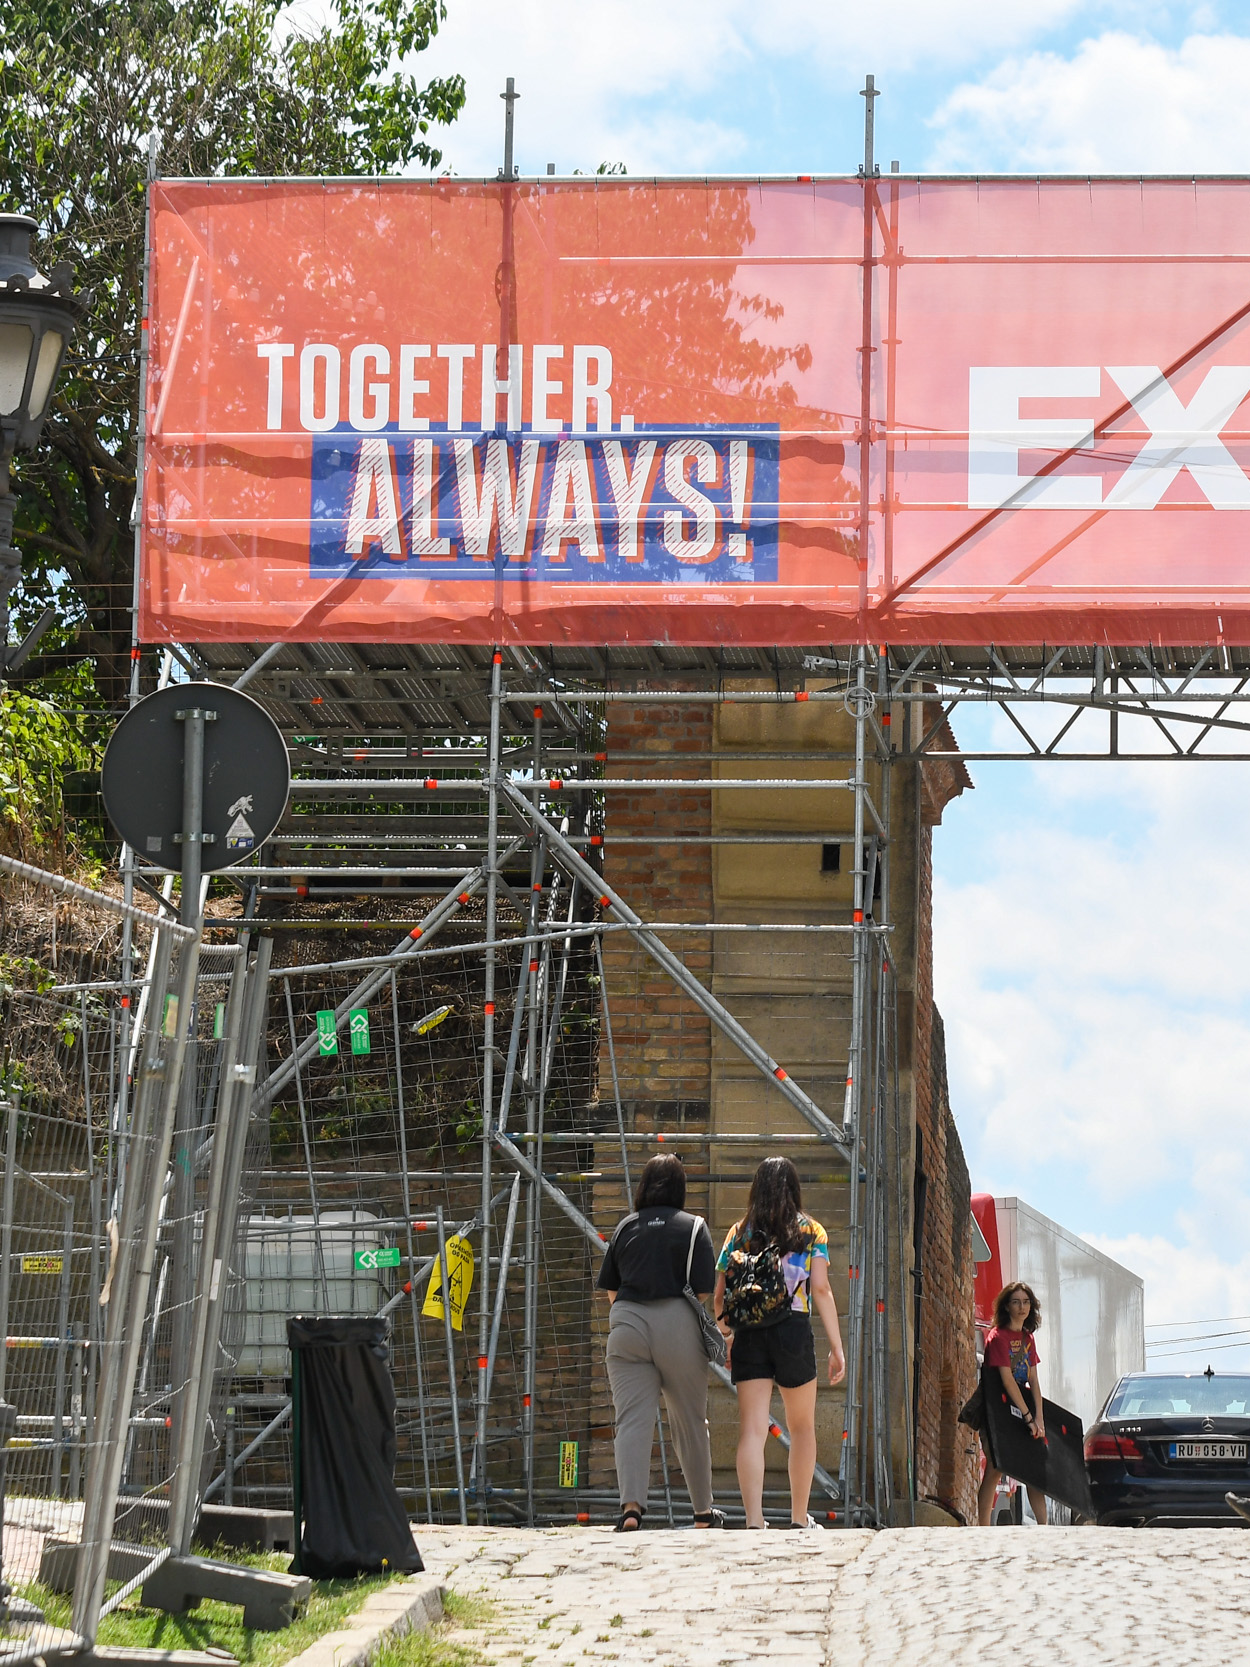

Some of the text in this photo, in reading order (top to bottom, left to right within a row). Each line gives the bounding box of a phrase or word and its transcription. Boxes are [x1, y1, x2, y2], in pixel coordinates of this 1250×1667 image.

[257, 343, 635, 432] TOGETHER.
[343, 437, 752, 560] ALWAYS!
[1178, 1444, 1194, 1457] RU
